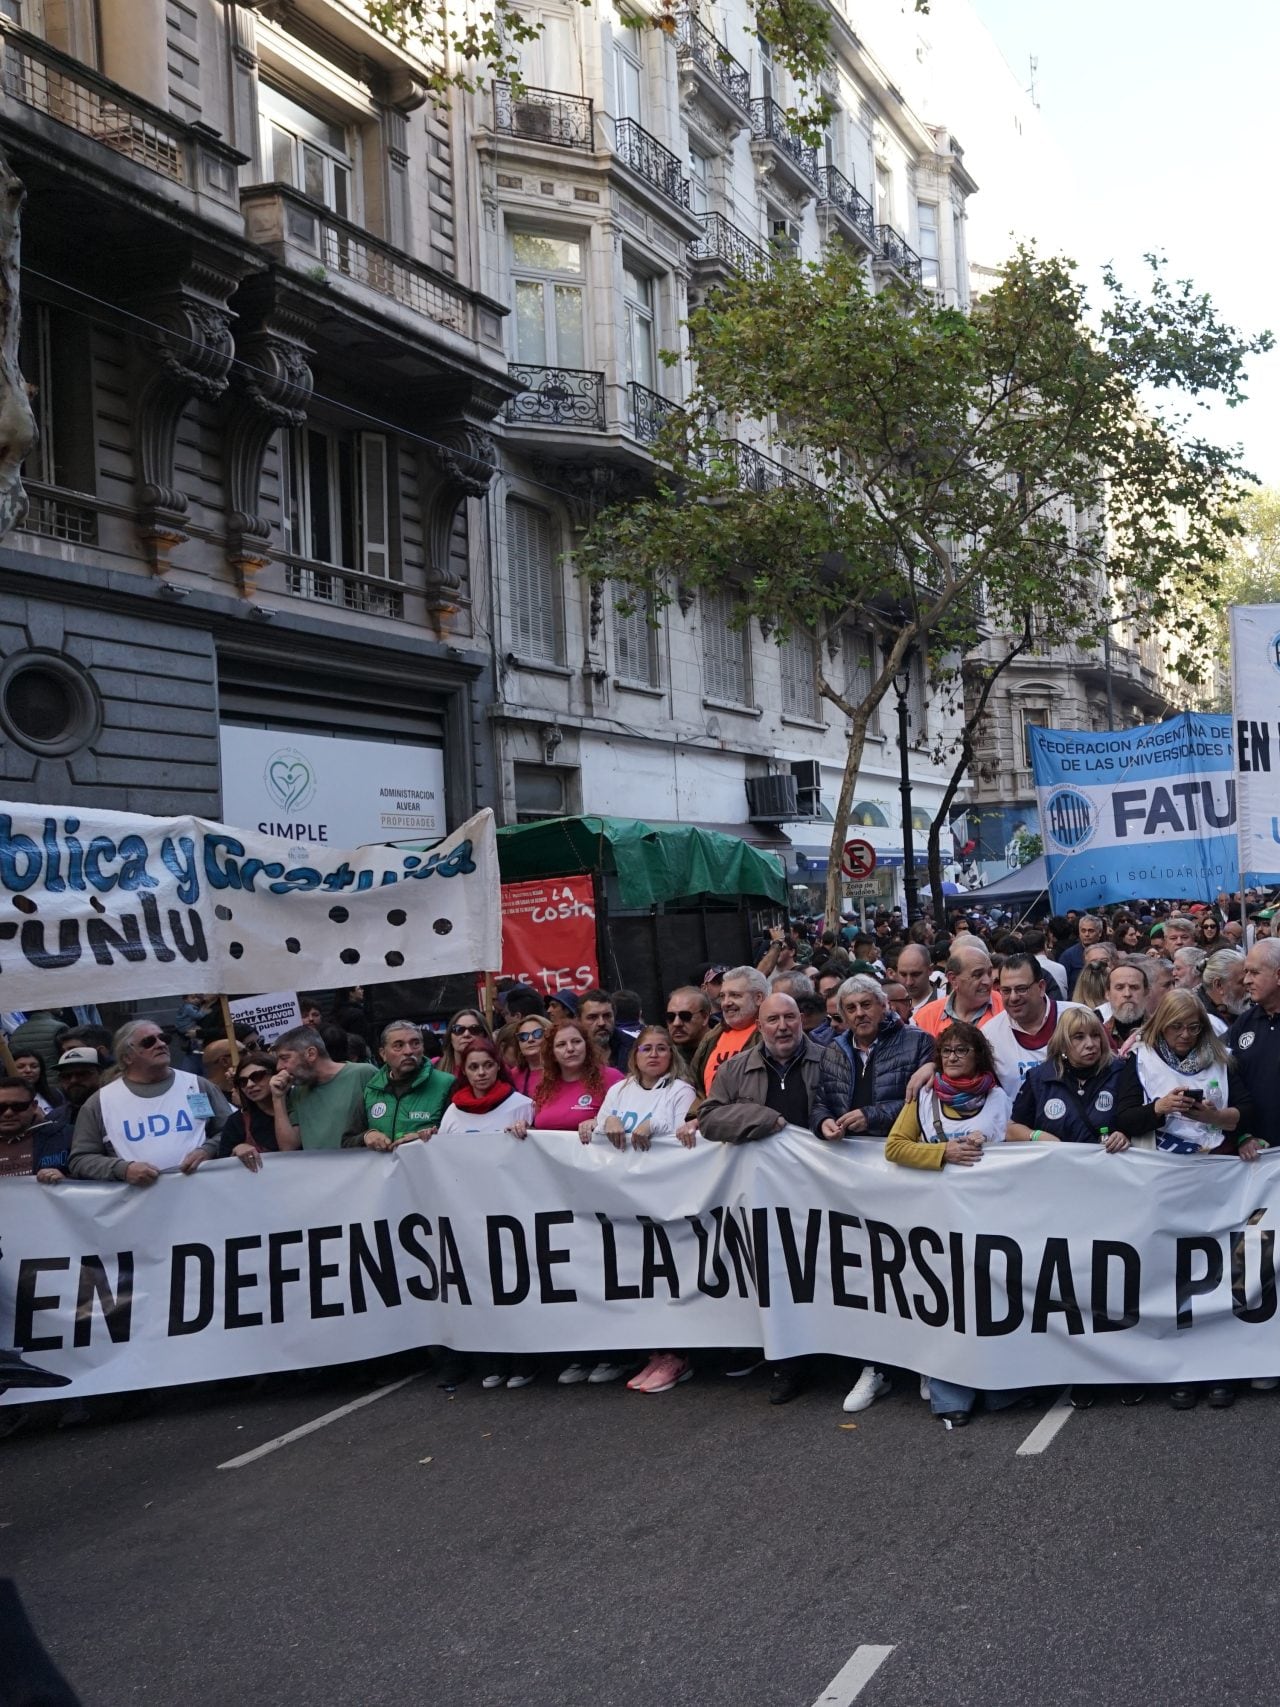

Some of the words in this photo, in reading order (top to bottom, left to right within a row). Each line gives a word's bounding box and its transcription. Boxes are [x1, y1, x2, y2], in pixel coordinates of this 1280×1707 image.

[1137, 725, 1207, 749] ARGENTINA
[1211, 727, 1233, 738] DE
[1237, 720, 1271, 772] EN
[1062, 759, 1081, 771] DE
[1086, 758, 1114, 771] LAS
[1119, 743, 1224, 768] UNIVERSIDADES
[396, 801, 421, 812] ALVEAR
[381, 815, 436, 828] PROPIEDADES
[1051, 794, 1092, 845] FATUN
[258, 822, 328, 842] SIMPLE
[161, 837, 199, 904] y
[1056, 874, 1107, 894] UNIDAD
[1128, 867, 1223, 881] SOLIDARIDAD
[552, 887, 575, 901] LA
[256, 1001, 296, 1015] Suprema
[267, 1009, 294, 1020] FAVOR
[258, 1018, 289, 1033] pueblo
[123, 1109, 193, 1142] UDA
[15, 1251, 134, 1353] EN
[167, 1212, 472, 1337] DEFENSA
[487, 1210, 577, 1308] DE
[595, 1212, 680, 1300] LA
[685, 1206, 1141, 1338] UNIVERSIDAD
